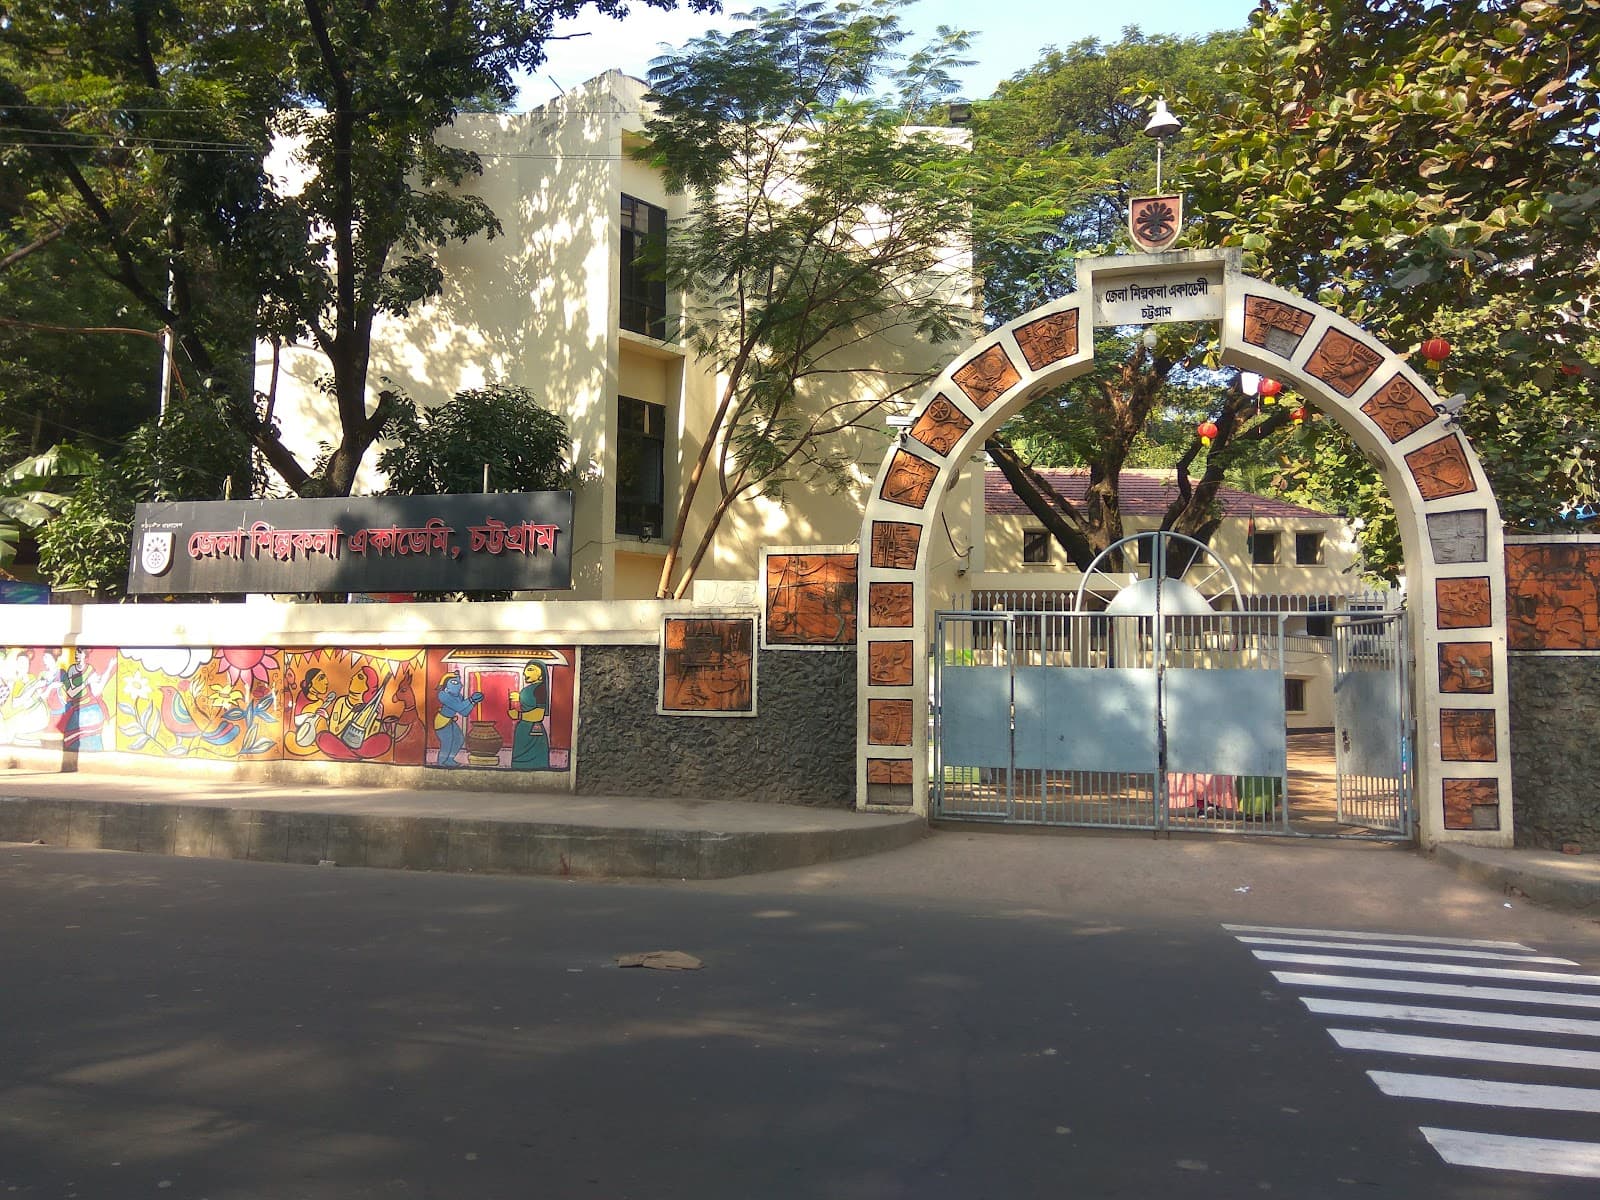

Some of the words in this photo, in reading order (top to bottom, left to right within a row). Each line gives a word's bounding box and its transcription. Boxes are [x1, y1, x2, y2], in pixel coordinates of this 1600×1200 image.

[1106, 286, 1128, 303] জেলা
[1130, 283, 1167, 301] শিল্পকলা
[1168, 277, 1208, 298] একাডেমী
[1140, 304, 1172, 319] চট্টগ্রাম
[188, 526, 249, 559] জেলা
[249, 520, 343, 560] শিল্পকলা
[348, 517, 460, 559] একাডেমি,
[467, 515, 560, 557] চট্টগ্রাম
